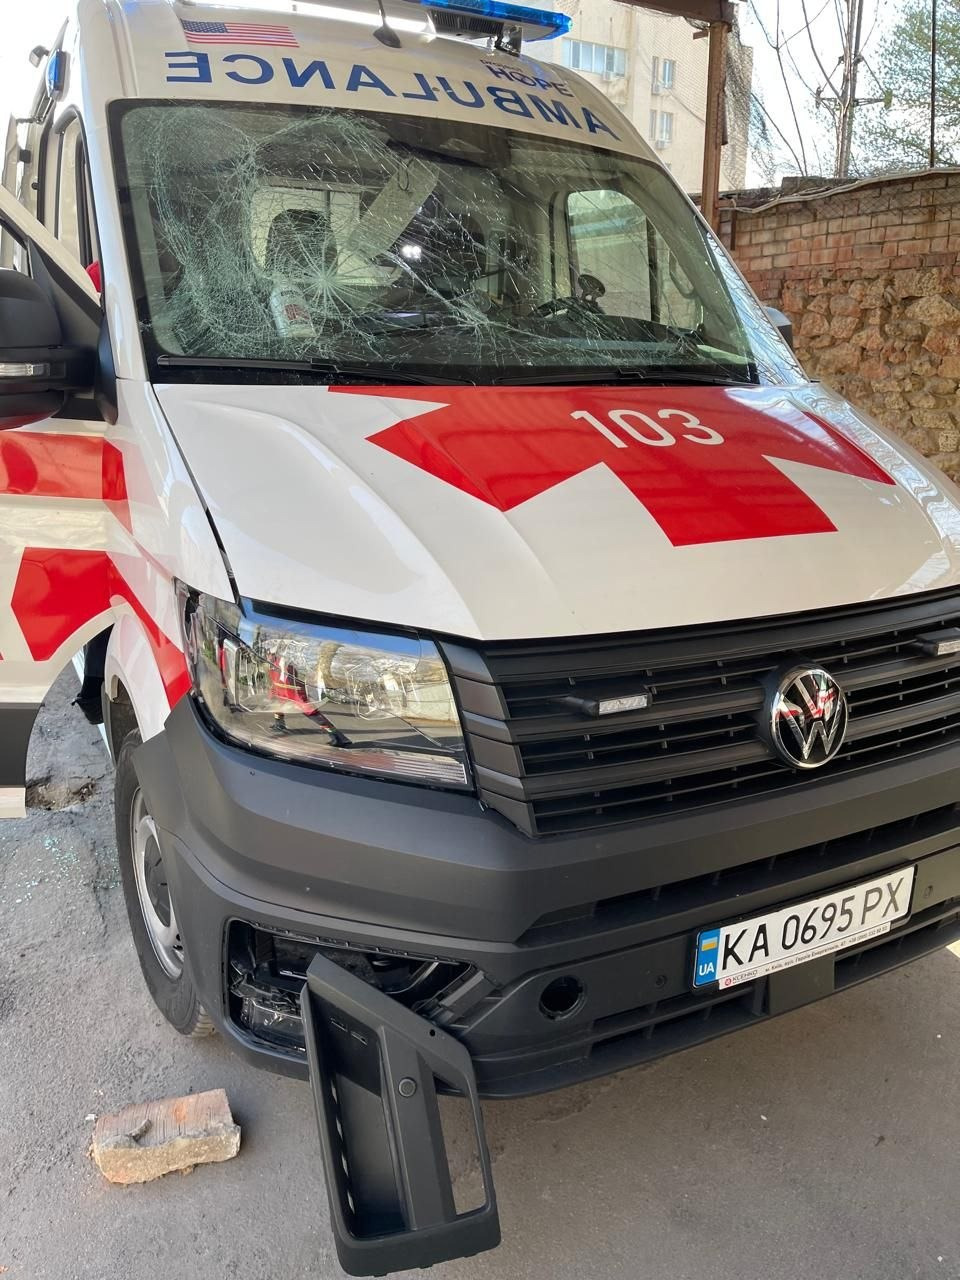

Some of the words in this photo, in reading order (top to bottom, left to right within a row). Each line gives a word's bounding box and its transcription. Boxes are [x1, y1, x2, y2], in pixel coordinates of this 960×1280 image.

[486, 64, 574, 98] HOPE
[570, 409, 725, 449] 103
[781, 895, 855, 951] 0695
[699, 964, 715, 976] UA
